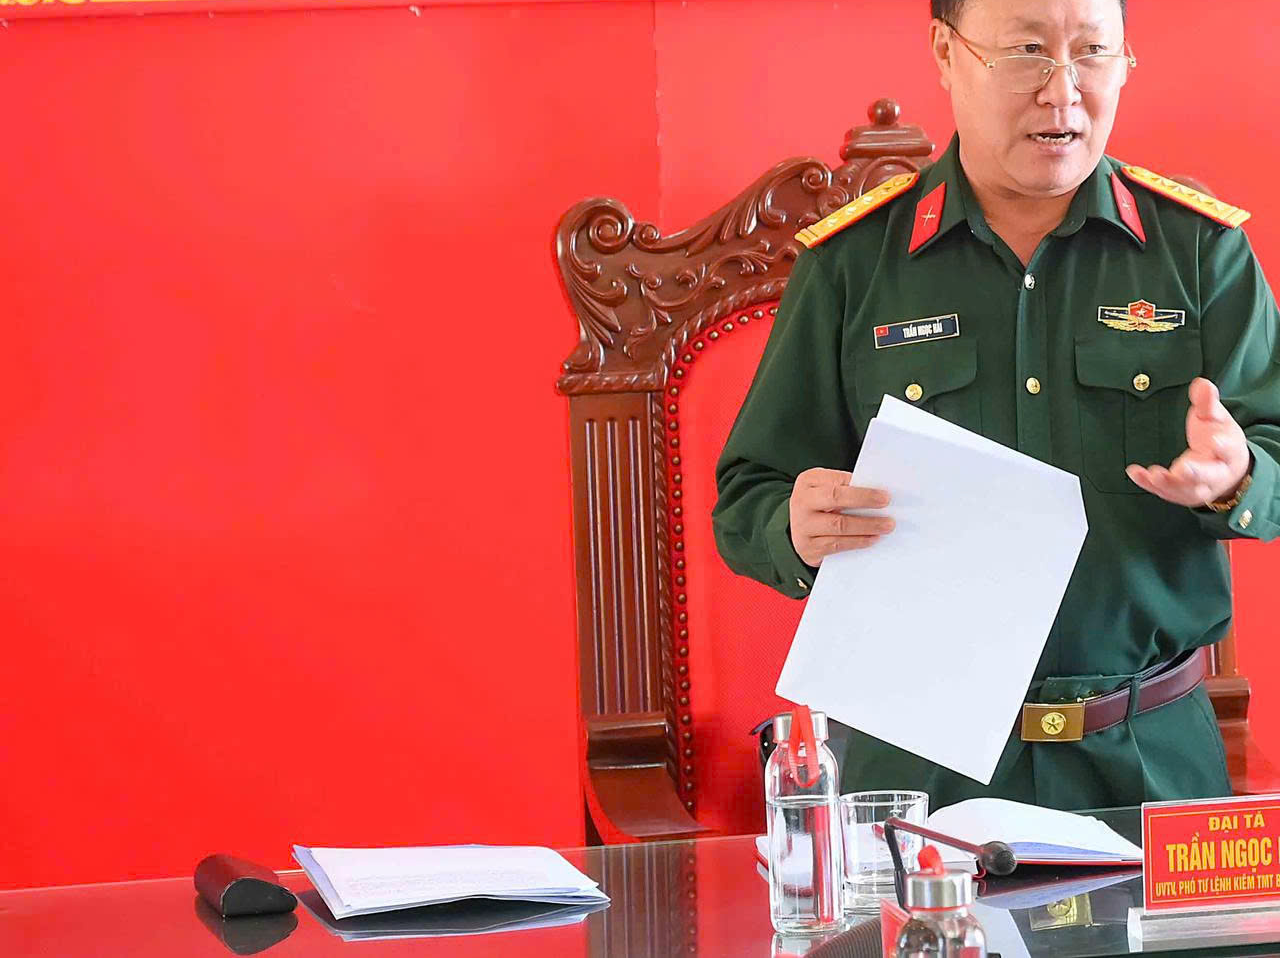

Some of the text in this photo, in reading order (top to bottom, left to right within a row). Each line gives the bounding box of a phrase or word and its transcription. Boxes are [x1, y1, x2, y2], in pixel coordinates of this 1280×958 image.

[1208, 815, 1238, 833] ĐẠI
[1166, 832, 1216, 873] TRẦN
[1221, 837, 1272, 873] NGỌC
[1179, 877, 1196, 895] PHÓ
[1198, 878, 1210, 893] TƯ
[1210, 875, 1232, 895] LỆNH
[1257, 874, 1274, 889] TMT
